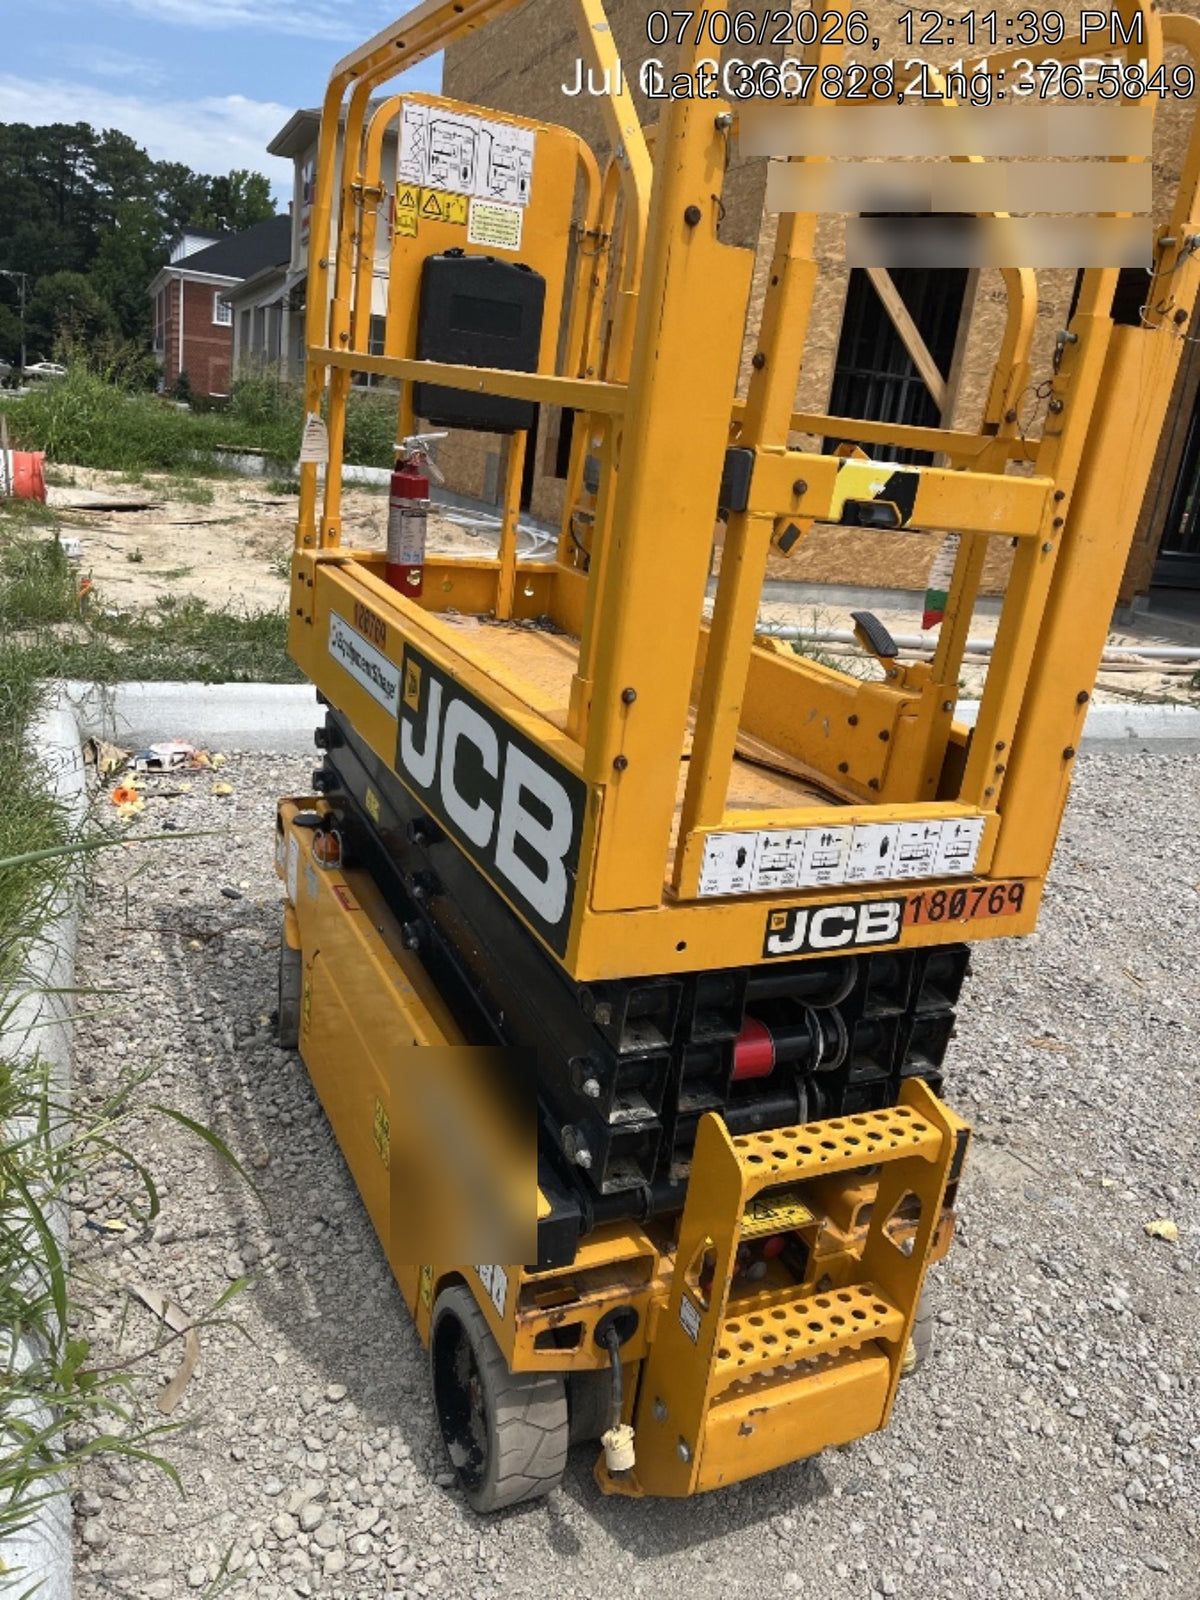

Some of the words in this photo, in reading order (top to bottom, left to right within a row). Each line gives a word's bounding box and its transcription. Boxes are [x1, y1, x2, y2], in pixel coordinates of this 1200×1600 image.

[401, 676, 574, 924] JCB
[767, 902, 903, 954] JCB
[910, 882, 1025, 924] 180769
